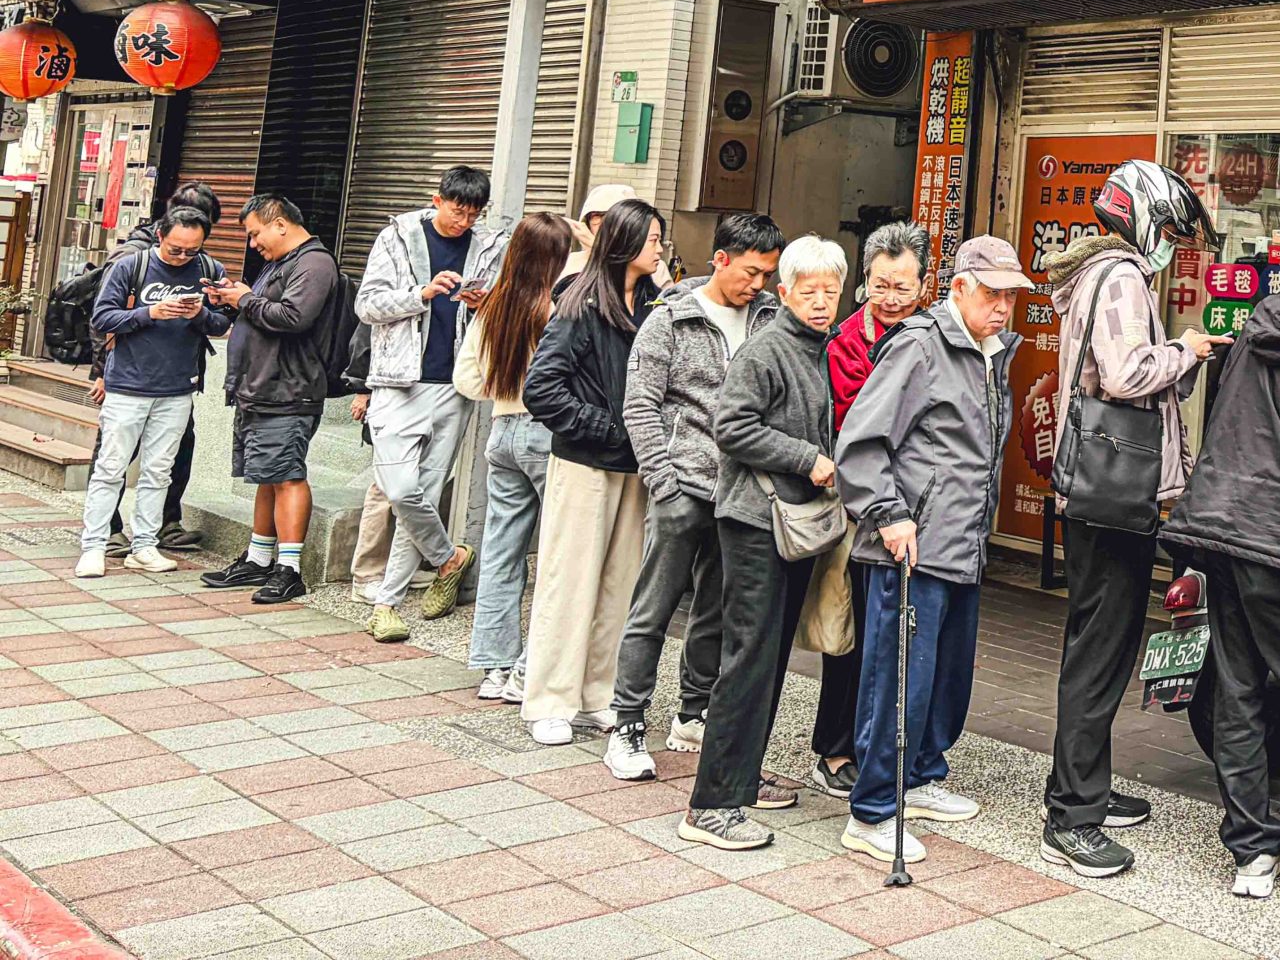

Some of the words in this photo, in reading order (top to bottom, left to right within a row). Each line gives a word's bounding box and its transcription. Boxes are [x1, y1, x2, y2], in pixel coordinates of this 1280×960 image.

[926, 58, 949, 143] 烘乾機
[949, 57, 970, 143] 超靜音
[1225, 152, 1258, 176] 24H
[1211, 269, 1252, 293] 毛毯
